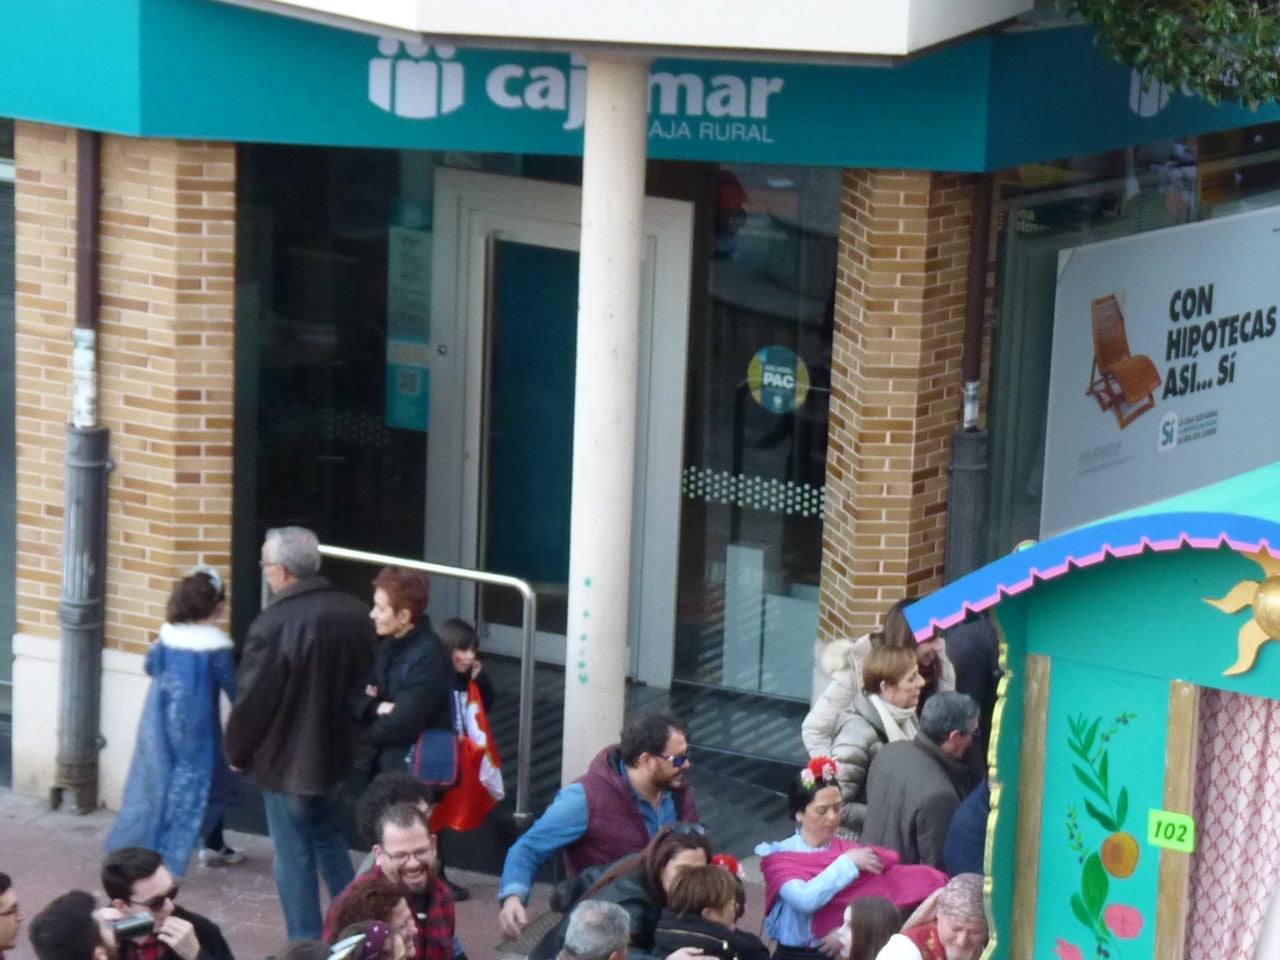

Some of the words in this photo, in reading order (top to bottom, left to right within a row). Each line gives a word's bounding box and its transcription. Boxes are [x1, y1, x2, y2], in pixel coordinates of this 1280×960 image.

[485, 52, 784, 130] cajmar
[649, 121, 691, 139] AJA
[699, 122, 774, 143] RURAL
[1169, 283, 1214, 322] CON
[1165, 305, 1277, 361] HIPOTECAS
[763, 372, 795, 389] PAC
[1154, 820, 1188, 843] 102
